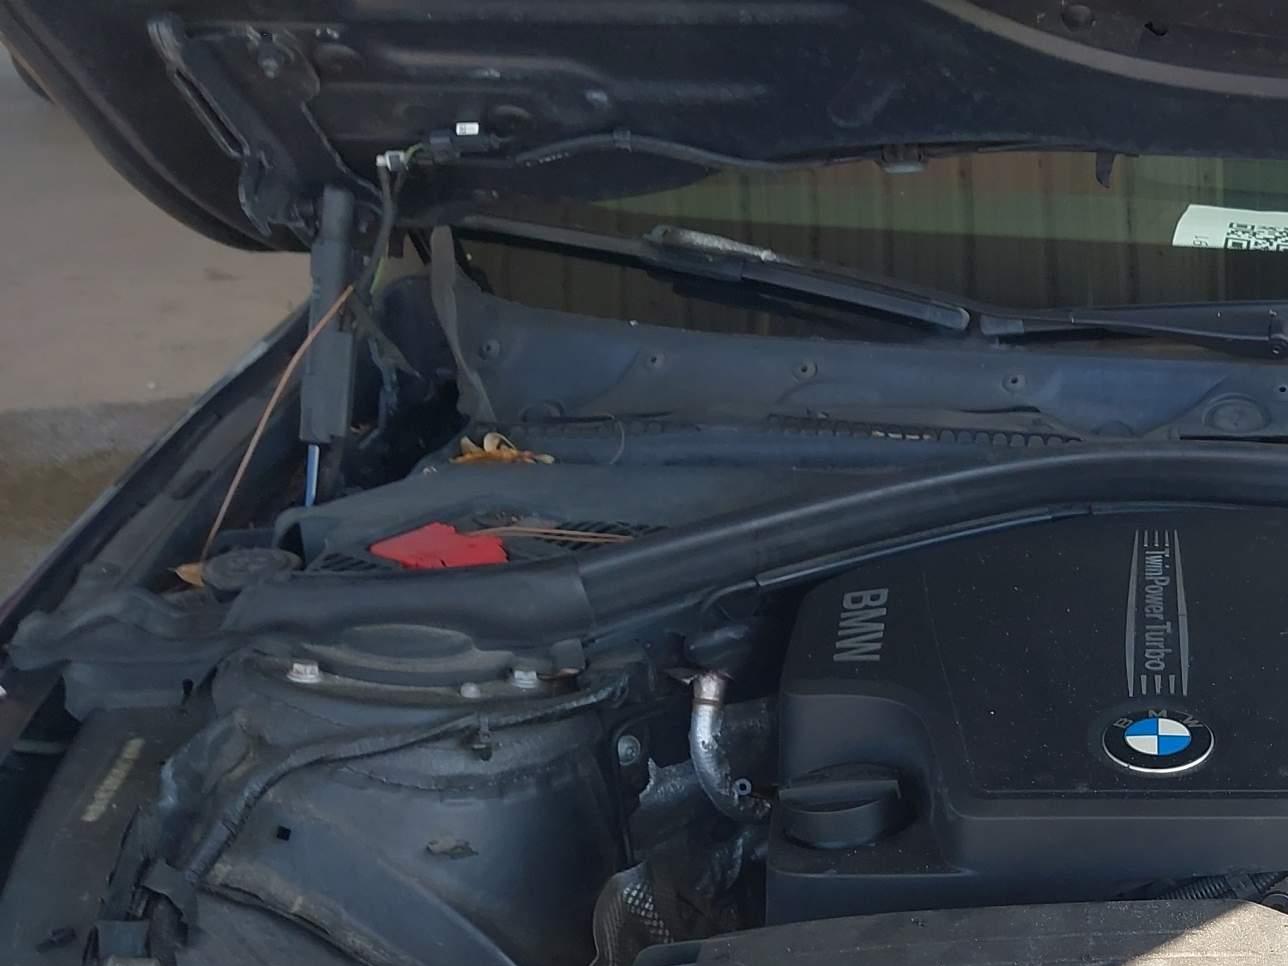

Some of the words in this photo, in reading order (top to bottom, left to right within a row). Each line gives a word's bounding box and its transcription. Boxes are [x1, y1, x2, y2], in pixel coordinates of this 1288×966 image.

[1144, 549, 1170, 620] TwinPower
[833, 588, 888, 661] BMW
[1144, 621, 1172, 671] Turbo
[1112, 709, 1203, 728] BMW
